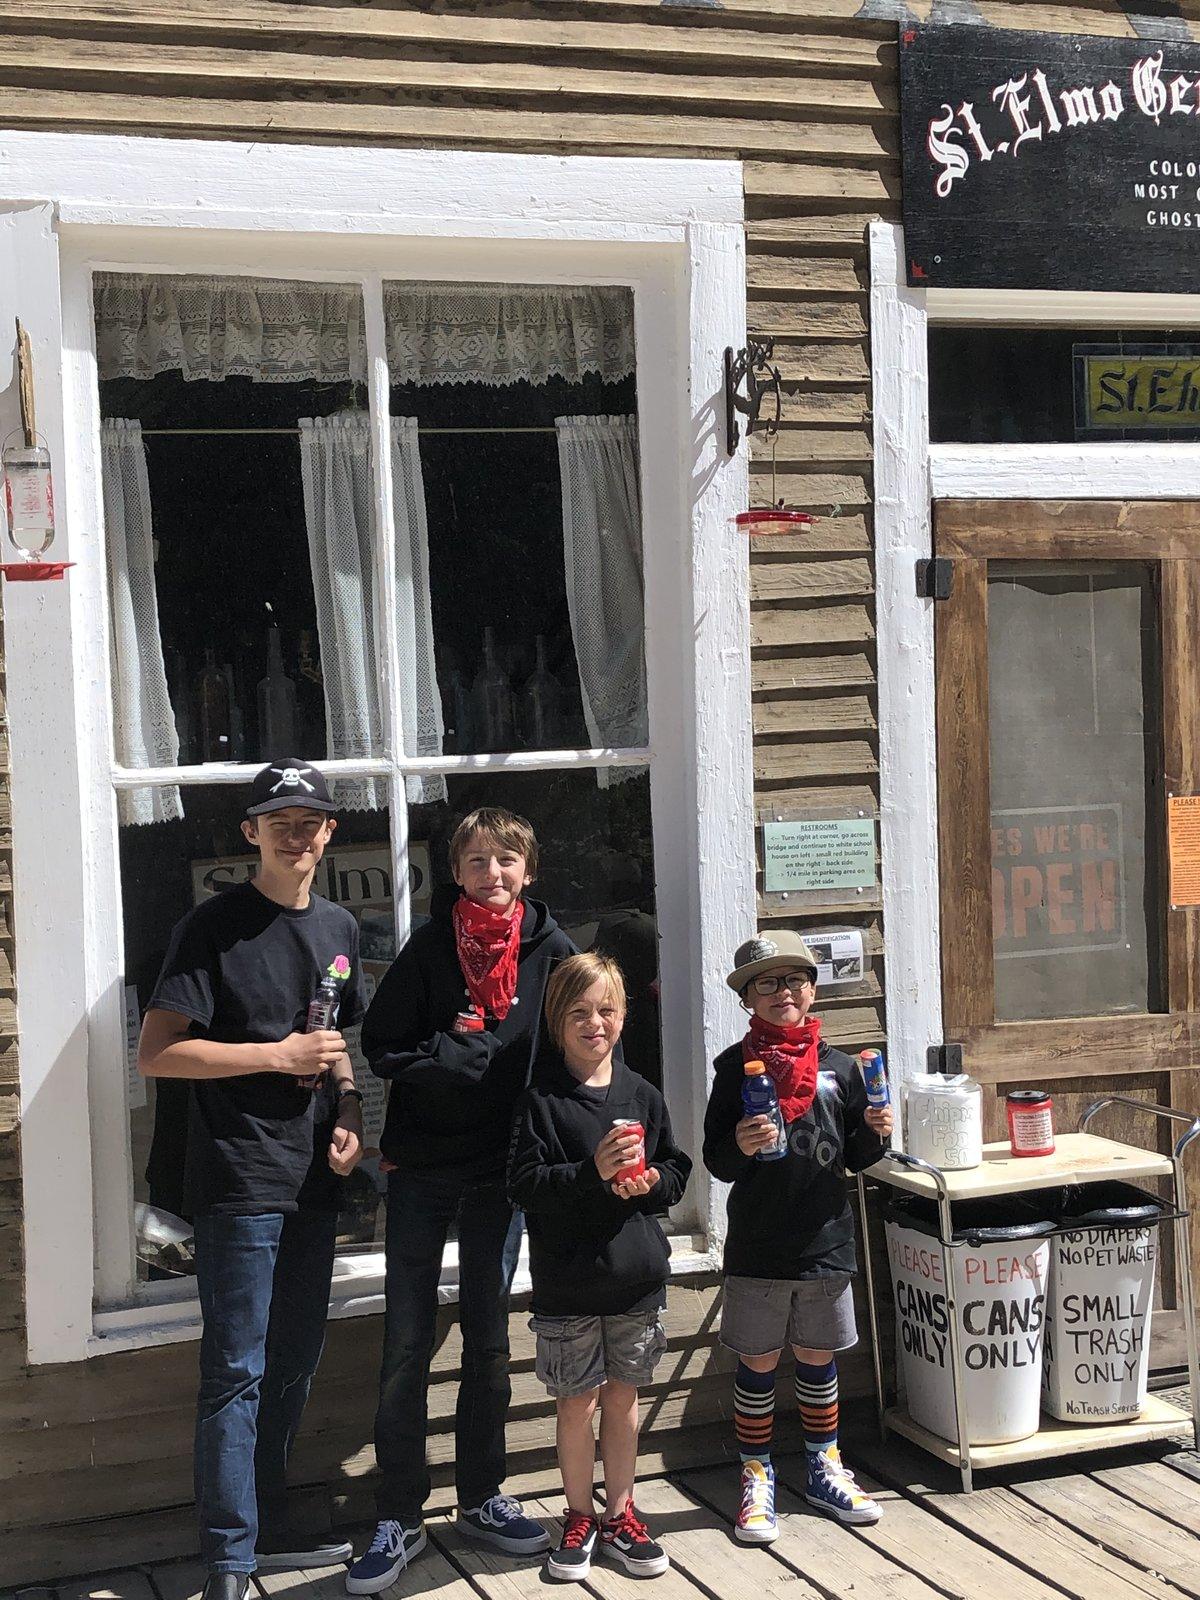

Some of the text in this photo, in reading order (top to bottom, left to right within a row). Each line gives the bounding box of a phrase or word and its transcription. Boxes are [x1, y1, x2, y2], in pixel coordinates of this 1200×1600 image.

[928, 49, 1200, 198] St. Elmo Ge
[1149, 160, 1200, 178] COLO
[1134, 183, 1179, 200] MOST
[1173, 798, 1196, 807] PLEASE
[796, 834, 811, 842] right
[800, 823, 838, 831] RESTROOMS
[767, 843, 787, 851] bridge
[990, 827, 1023, 856] ES
[771, 852, 789, 860] house
[844, 849, 868, 857] building
[805, 861, 821, 869] right
[314, 855, 423, 904] lmo
[806, 879, 821, 887] right
[819, 868, 842, 877] parking
[811, 934, 851, 943] IDENTIFICATION
[889, 1237, 943, 1283] PLEASE
[1058, 1243, 1155, 1267] NO PET WASTE
[964, 1251, 1043, 1285] PLEASE
[896, 1279, 949, 1334] CANS
[962, 1294, 1045, 1337] CANS
[1062, 1293, 1144, 1324] SMALL
[901, 1319, 947, 1368] ONLY
[964, 1335, 1041, 1371] ONLY
[1065, 1325, 1144, 1357] TRASH
[1073, 1360, 1138, 1385] ONLY
